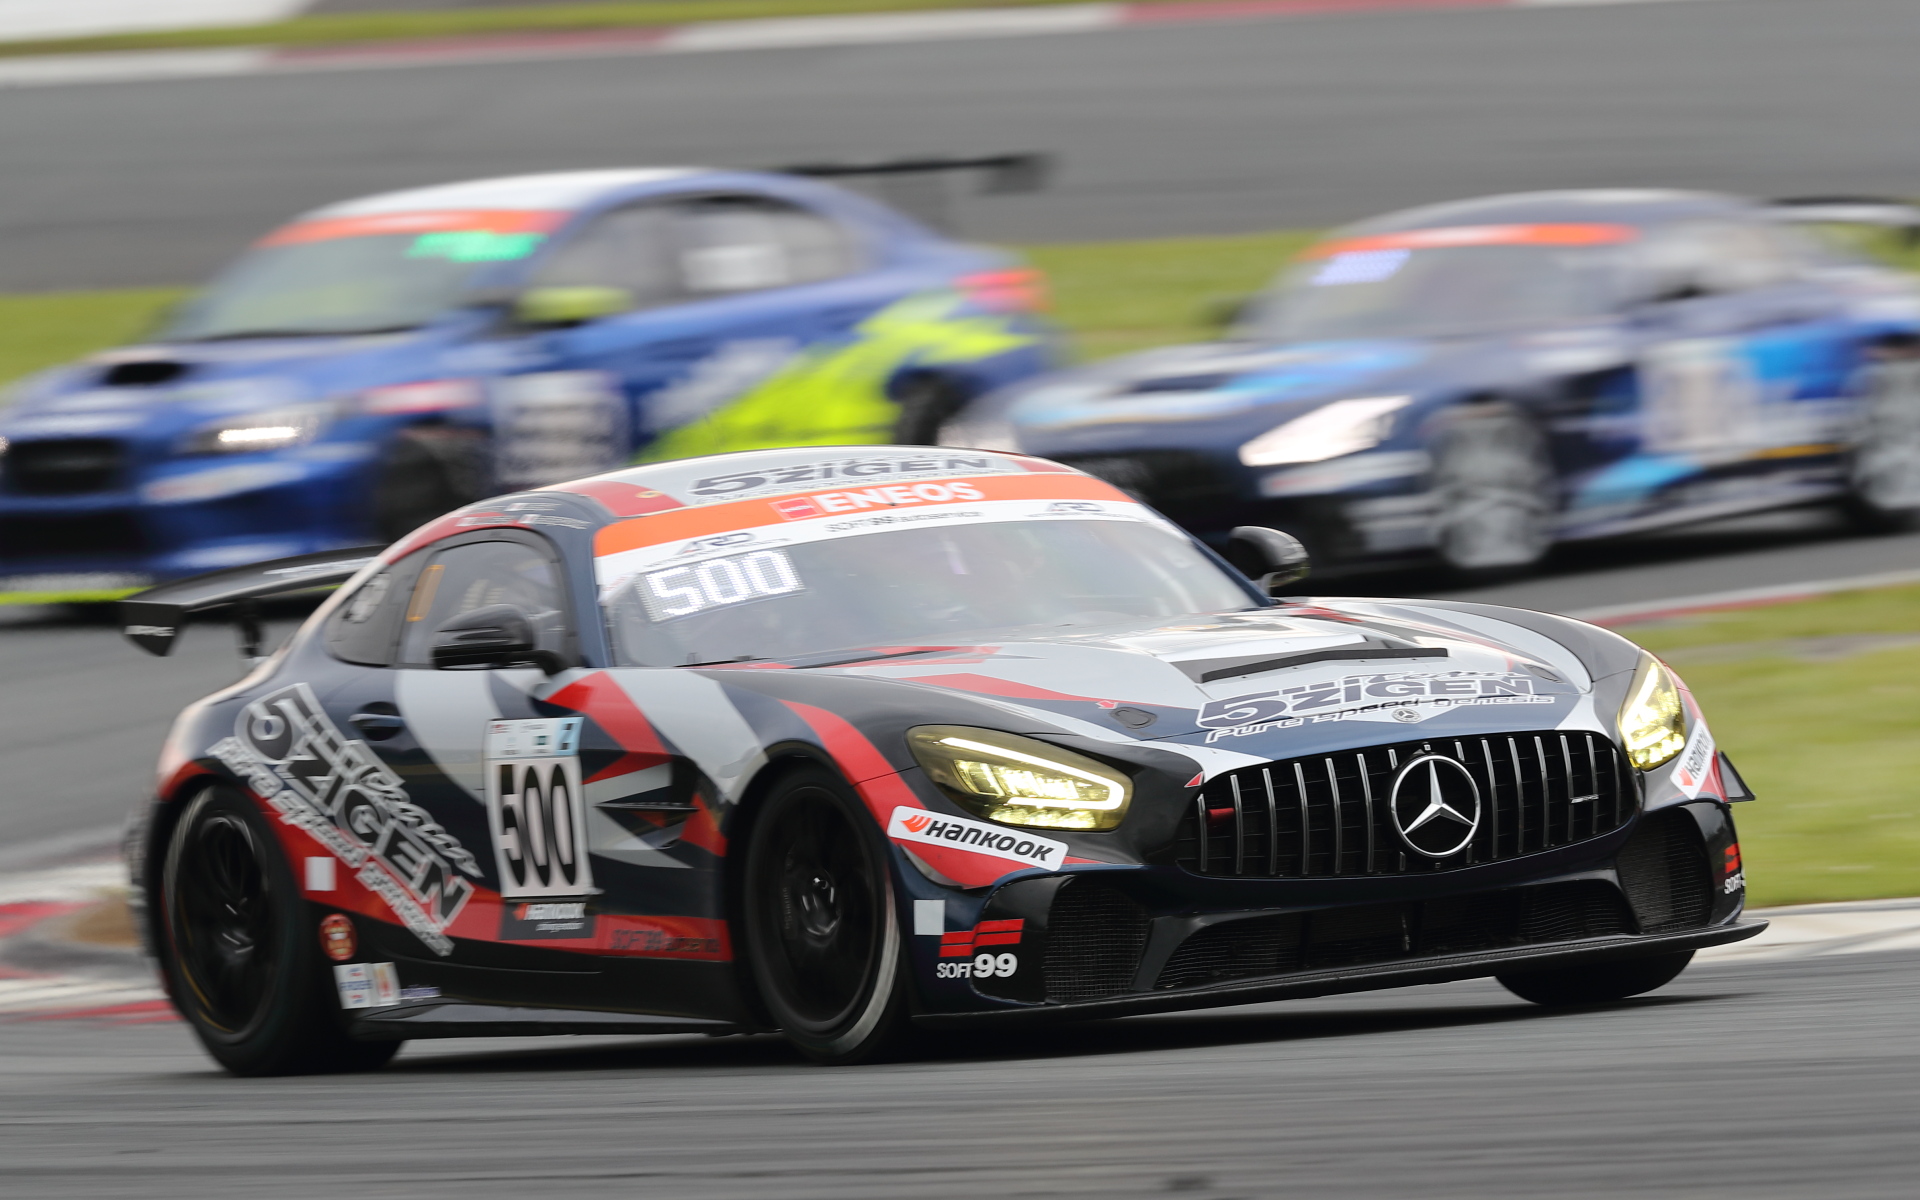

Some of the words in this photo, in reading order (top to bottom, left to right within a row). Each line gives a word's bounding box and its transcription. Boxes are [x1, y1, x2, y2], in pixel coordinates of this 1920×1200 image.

[808, 481, 986, 514] ENEOS
[645, 550, 799, 616] 500
[1204, 717, 1304, 745] Pure
[498, 763, 577, 888] 500
[936, 952, 1019, 979] SOFT99
